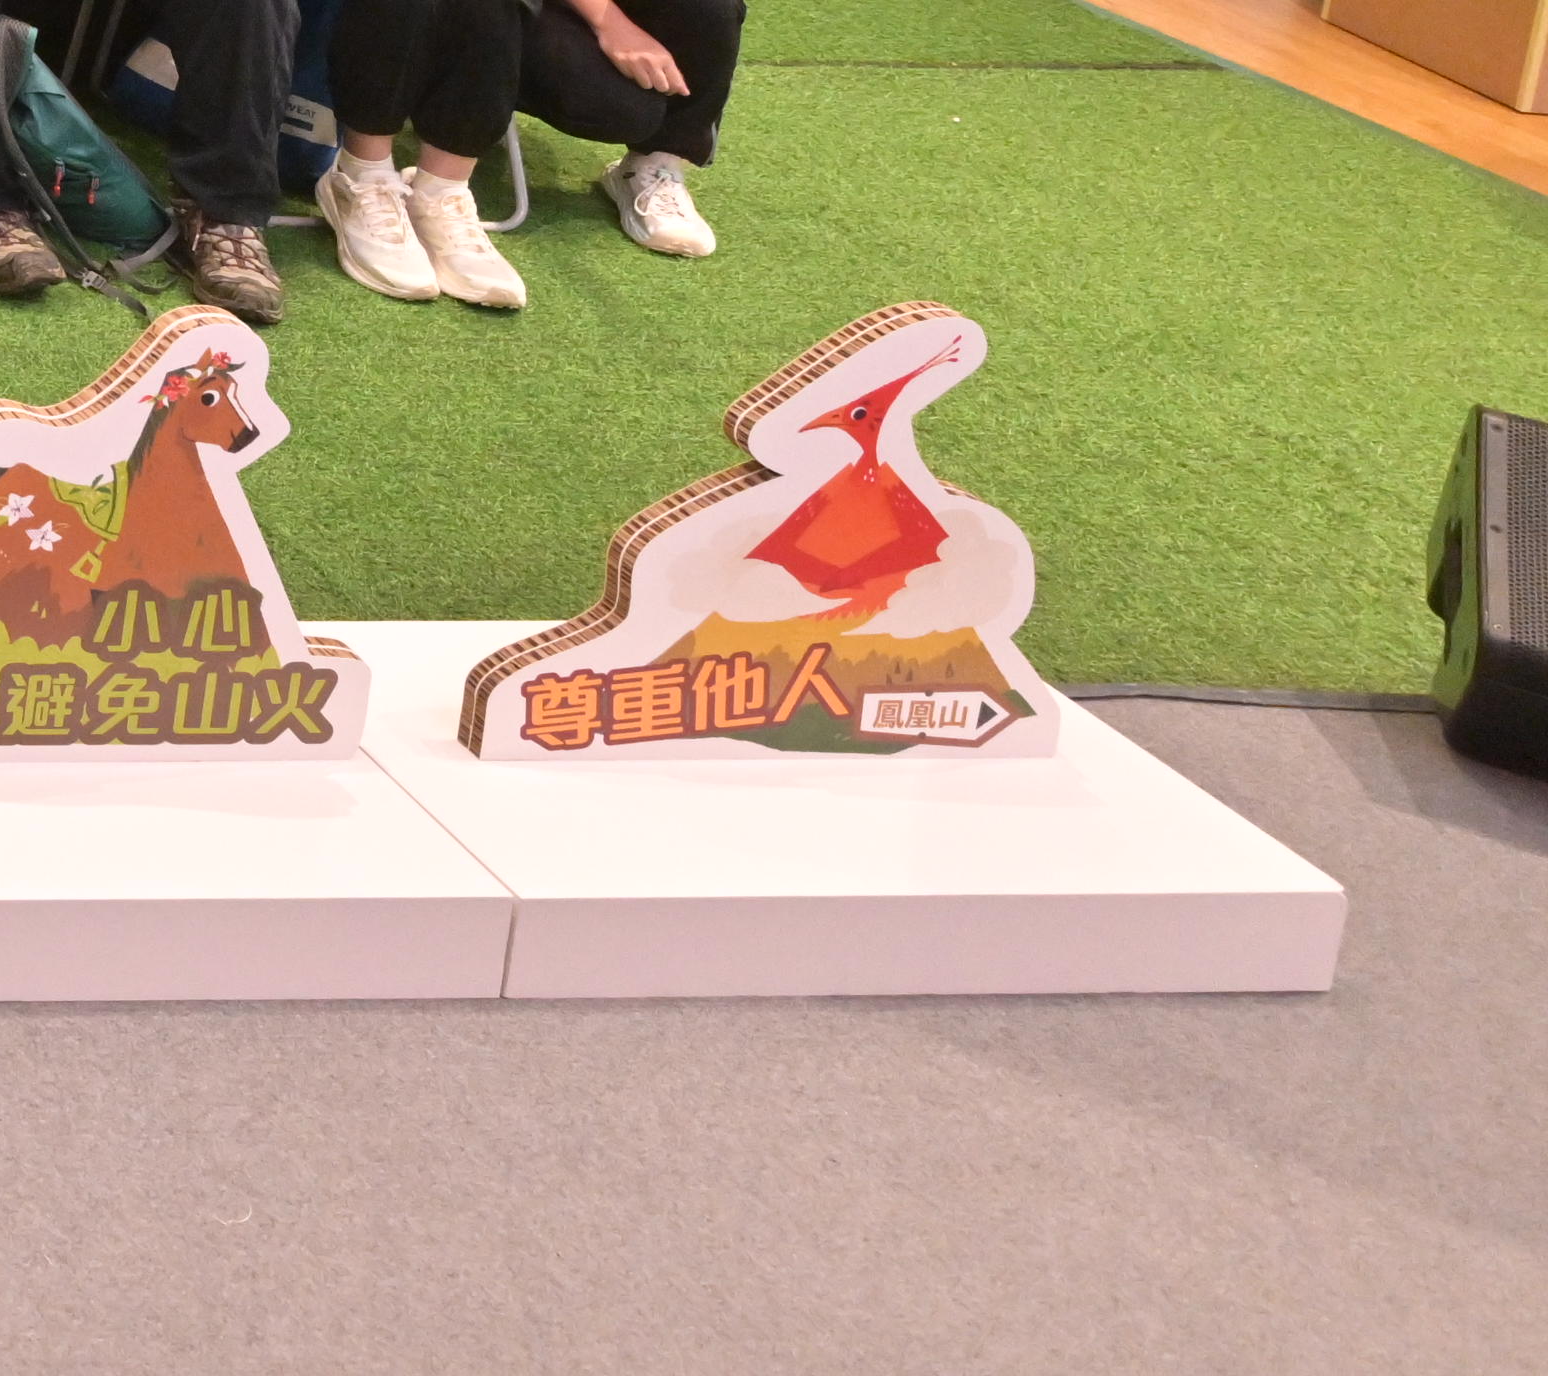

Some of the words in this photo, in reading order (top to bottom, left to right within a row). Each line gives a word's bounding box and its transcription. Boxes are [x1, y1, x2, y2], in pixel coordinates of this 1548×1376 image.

[94, 588, 252, 654] 小心
[4, 672, 331, 738] 避免山火
[524, 648, 850, 745] 尊重他人
[872, 698, 968, 731] 鳳凰山
